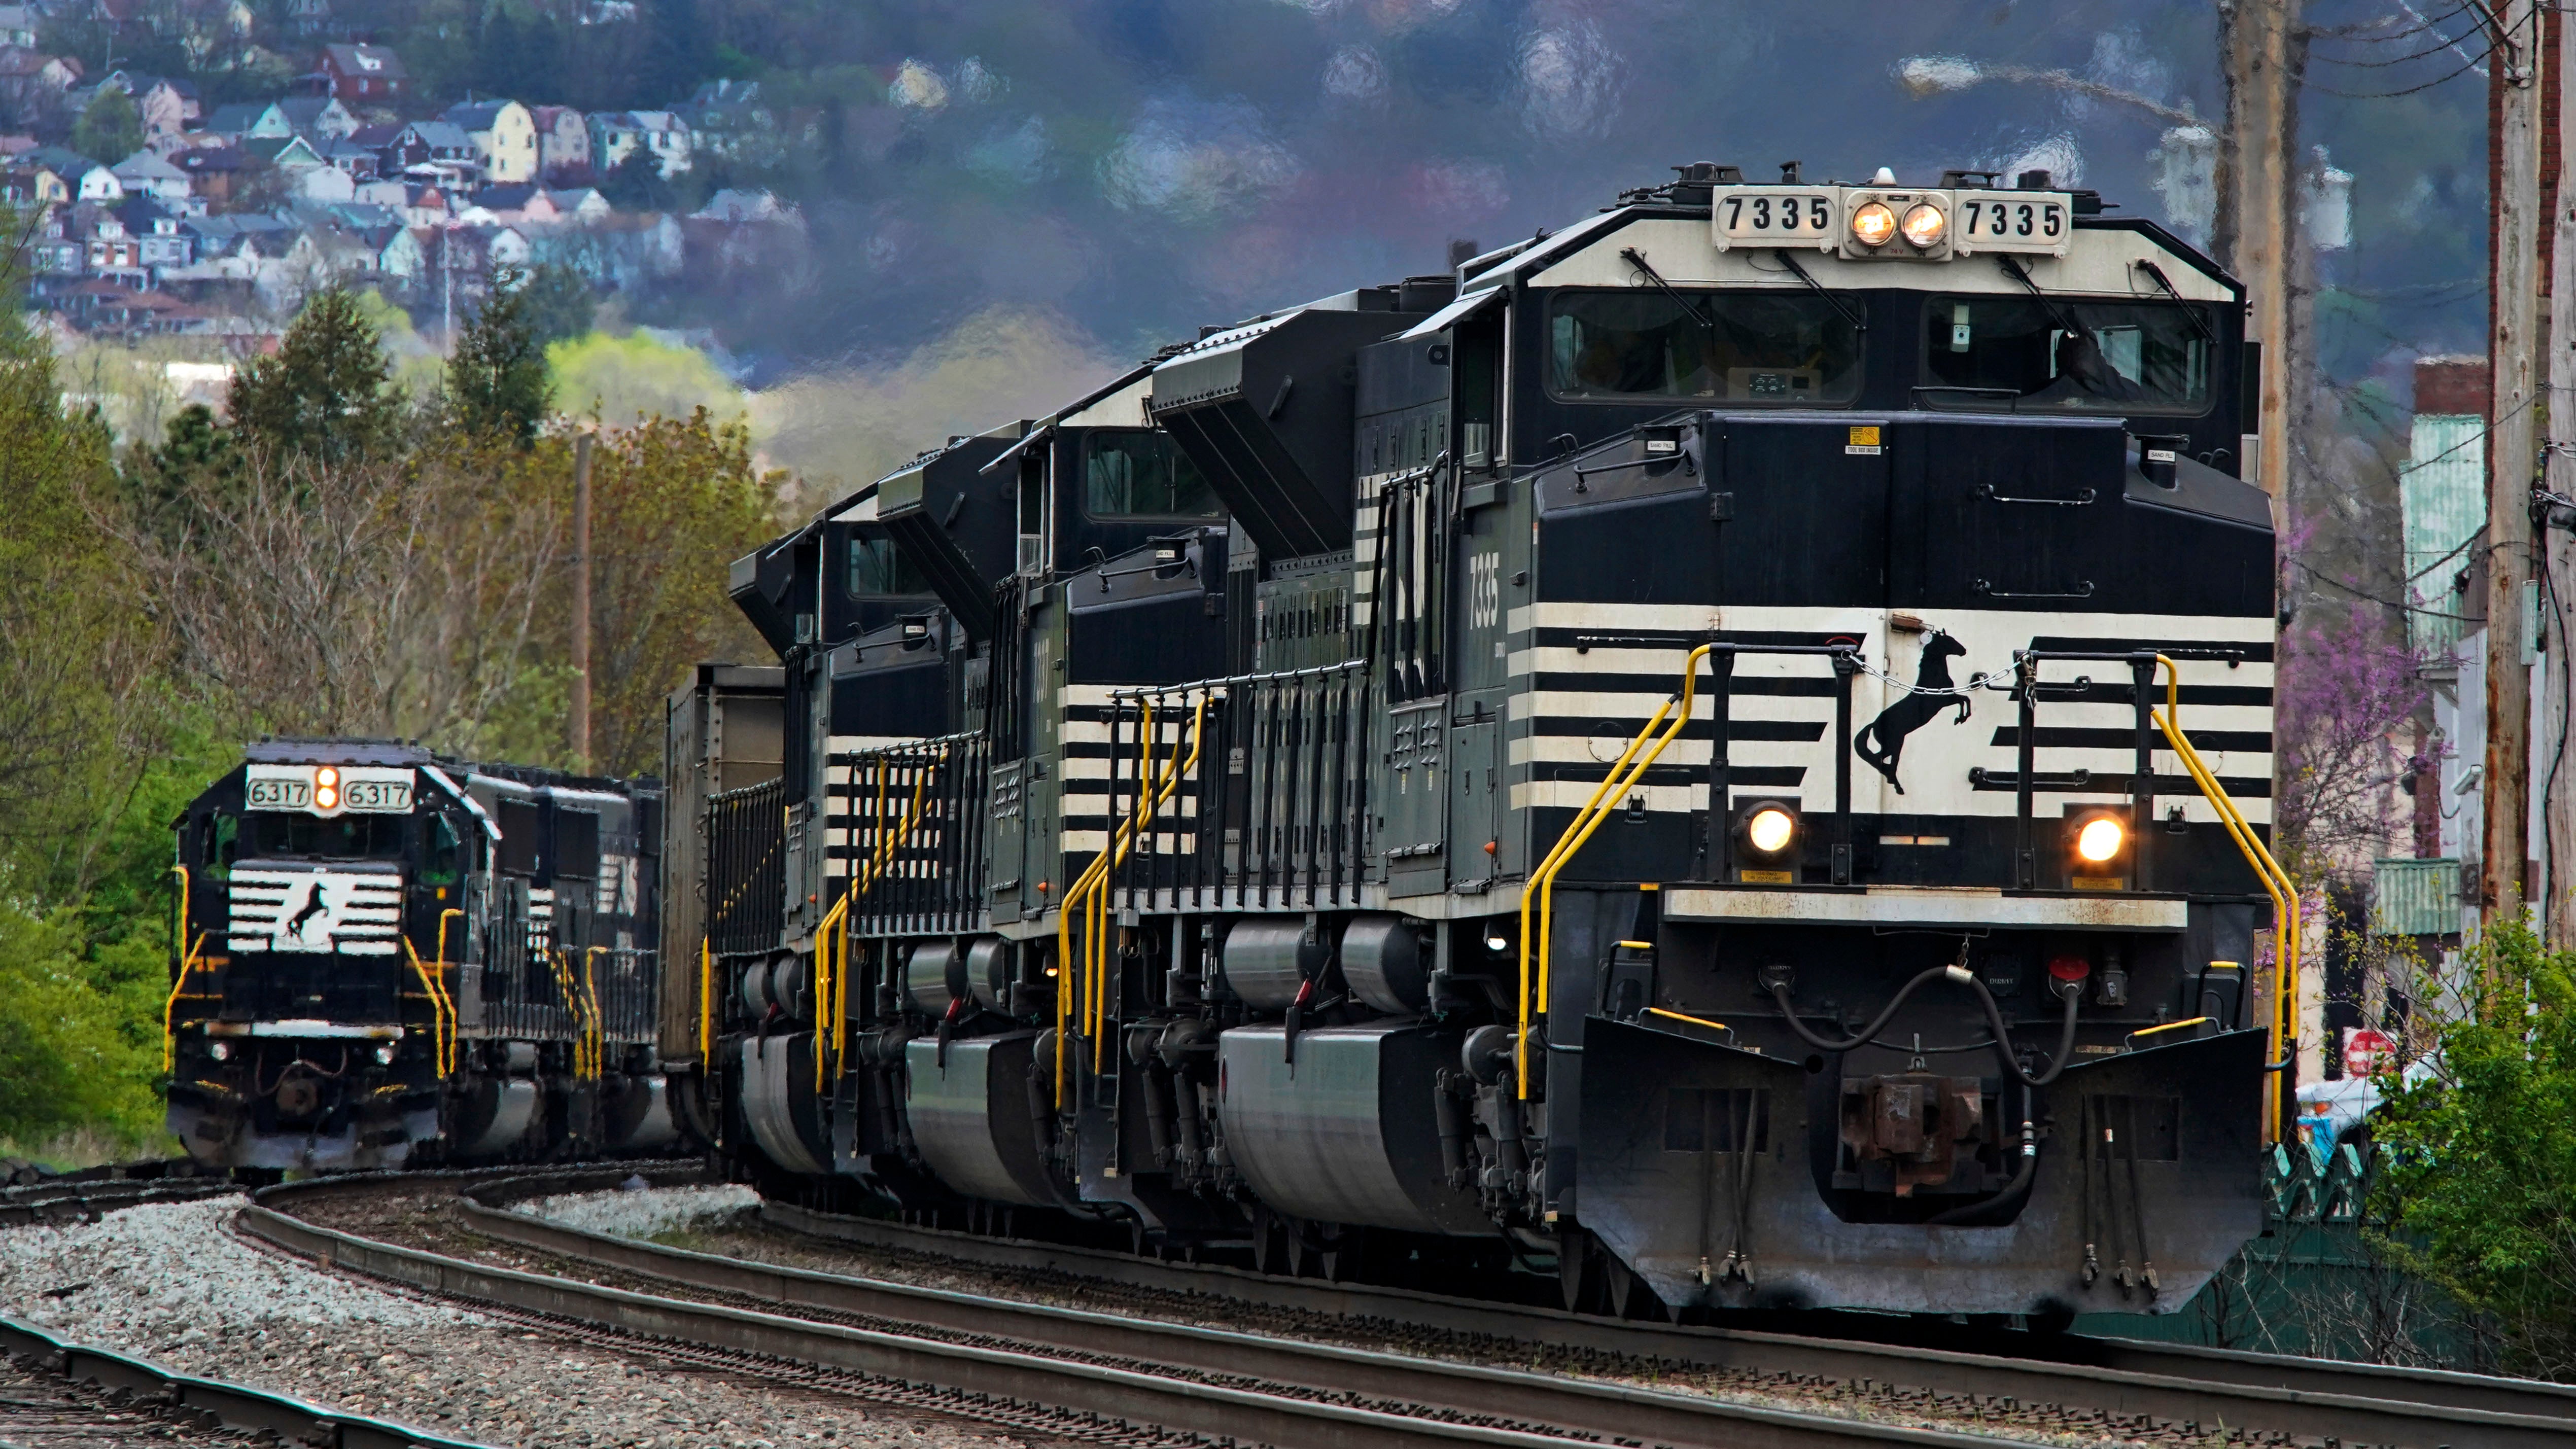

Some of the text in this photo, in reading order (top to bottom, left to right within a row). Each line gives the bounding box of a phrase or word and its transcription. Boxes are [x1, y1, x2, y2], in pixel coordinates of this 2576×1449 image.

[1726, 197, 1828, 230] 7335
[1965, 202, 2061, 237] 7335
[1470, 552, 1499, 630] 7335
[251, 780, 306, 803] 6317
[349, 782, 408, 805] 6317
